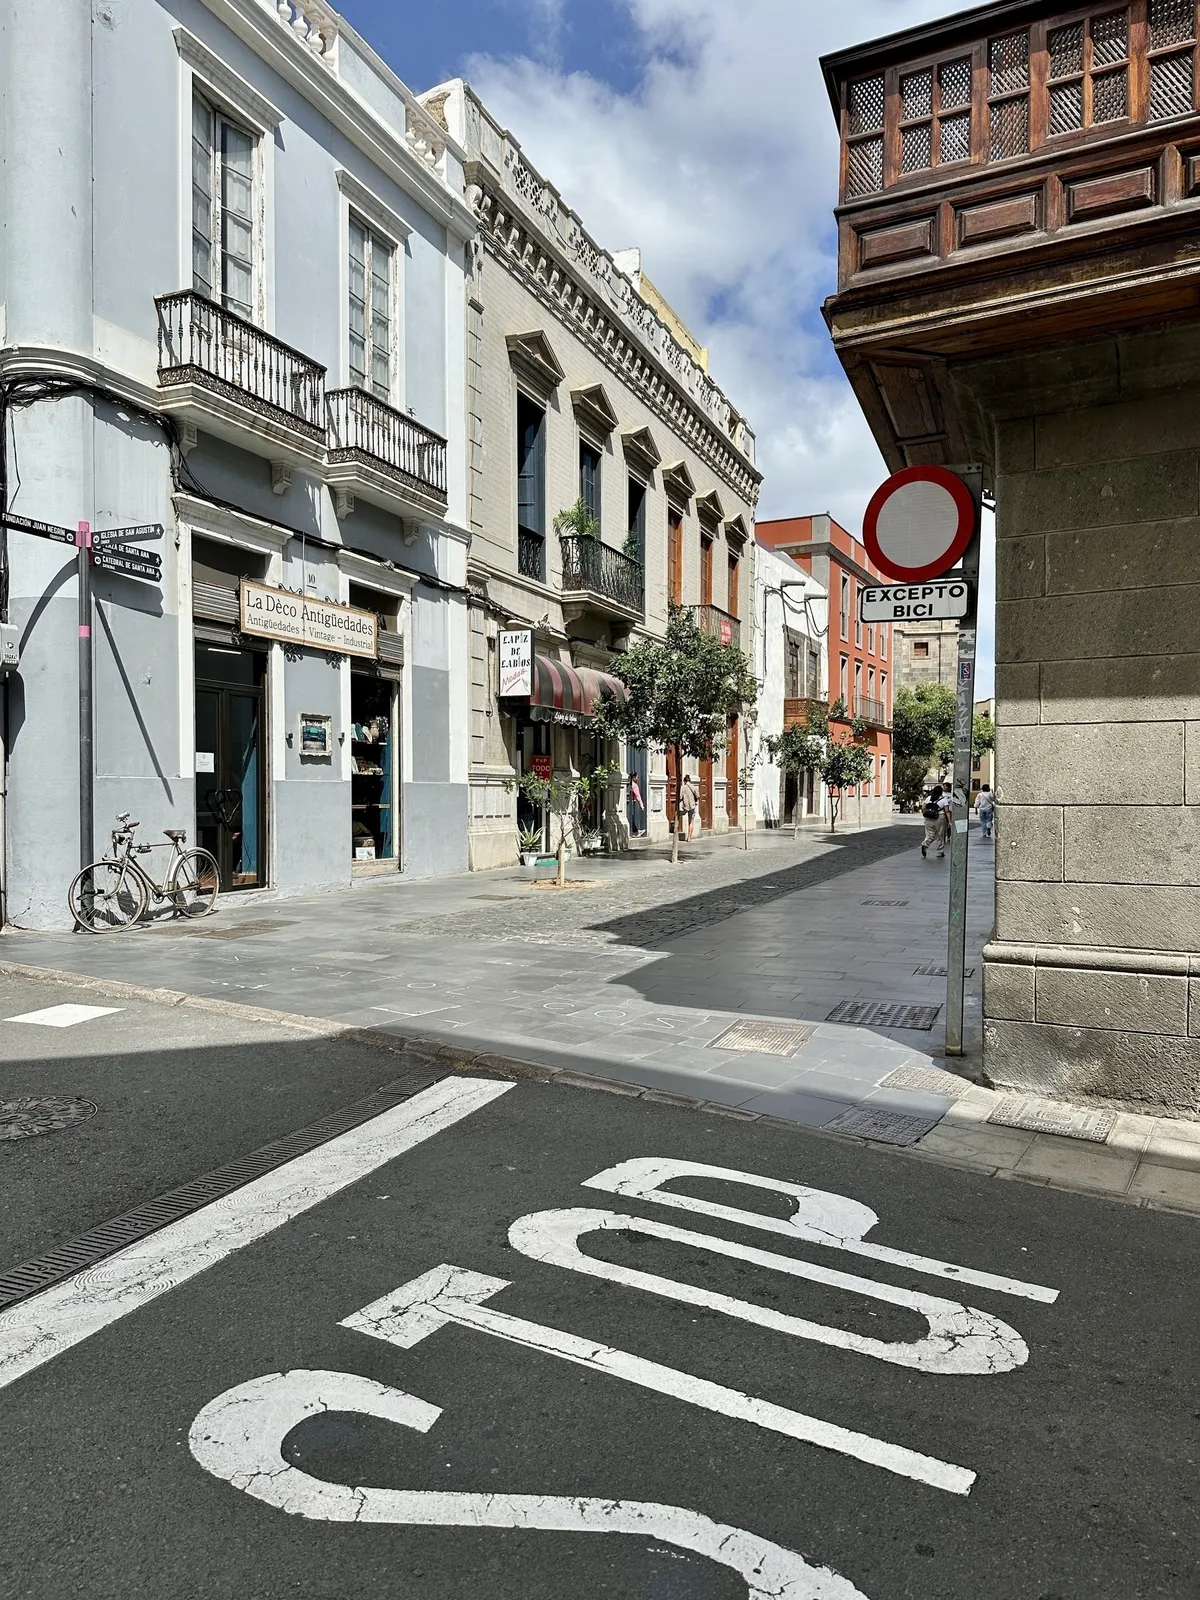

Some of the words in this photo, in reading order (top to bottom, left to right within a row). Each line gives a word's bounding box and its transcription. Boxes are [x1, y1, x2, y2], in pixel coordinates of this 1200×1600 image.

[2, 512, 31, 527] FUNDACIÓN
[32, 521, 47, 532] JUAN
[47, 524, 66, 537] NEGRÍN
[100, 530, 118, 540] IGLESIA
[118, 529, 125, 537] DE
[125, 528, 135, 536] SAN
[135, 525, 155, 535] AGUSTÍN
[118, 544, 125, 553] DE
[125, 546, 140, 557] SANTA
[102, 555, 125, 568] CATEDRAL
[125, 561, 132, 570] DE
[131, 563, 146, 573] SANTA
[145, 567, 156, 576] ANA
[308, 573, 316, 584] 10
[865, 584, 965, 603] EXCEPTO
[246, 589, 263, 610] La
[265, 594, 297, 618] Dèco
[301, 604, 374, 636] Antigüedades
[893, 603, 933, 618] BICI
[246, 613, 300, 635] Antigüedades
[308, 626, 335, 643] Vintage
[343, 634, 374, 651] Industrial
[510, 647, 521, 656] DE
[501, 658, 531, 668] LABIOS
[501, 667, 528, 692] Modas
[188, 1156, 1060, 1600] STOP
